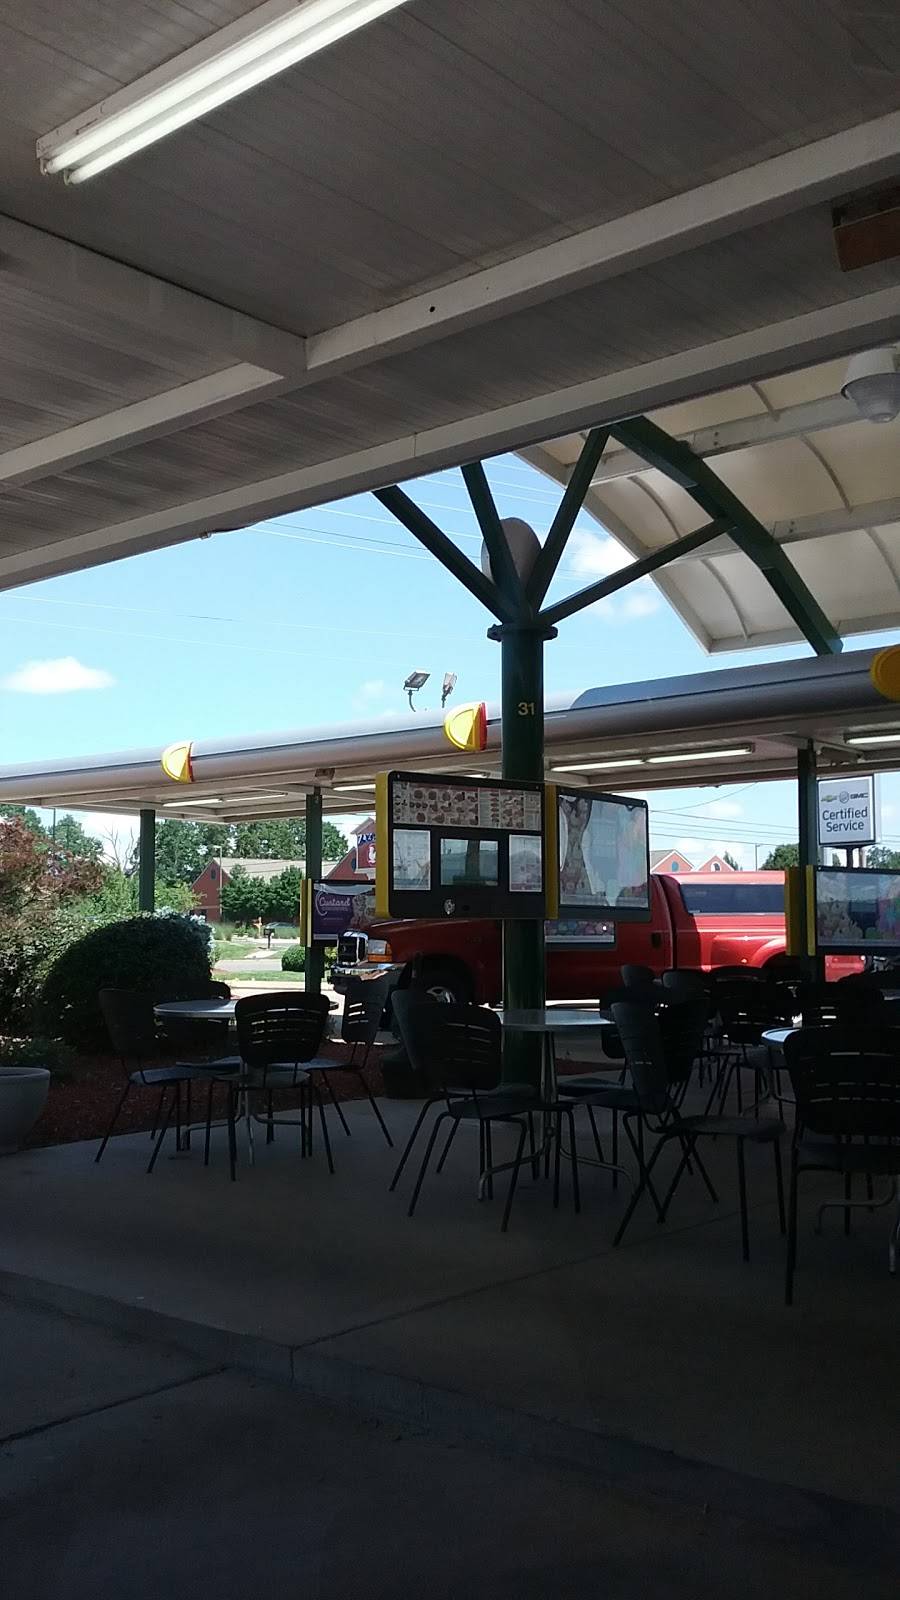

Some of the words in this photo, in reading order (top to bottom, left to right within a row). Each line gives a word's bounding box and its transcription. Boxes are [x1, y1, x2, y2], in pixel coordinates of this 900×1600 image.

[518, 702, 535, 716] 31
[822, 806, 868, 820] Certified
[826, 820, 865, 832] Service
